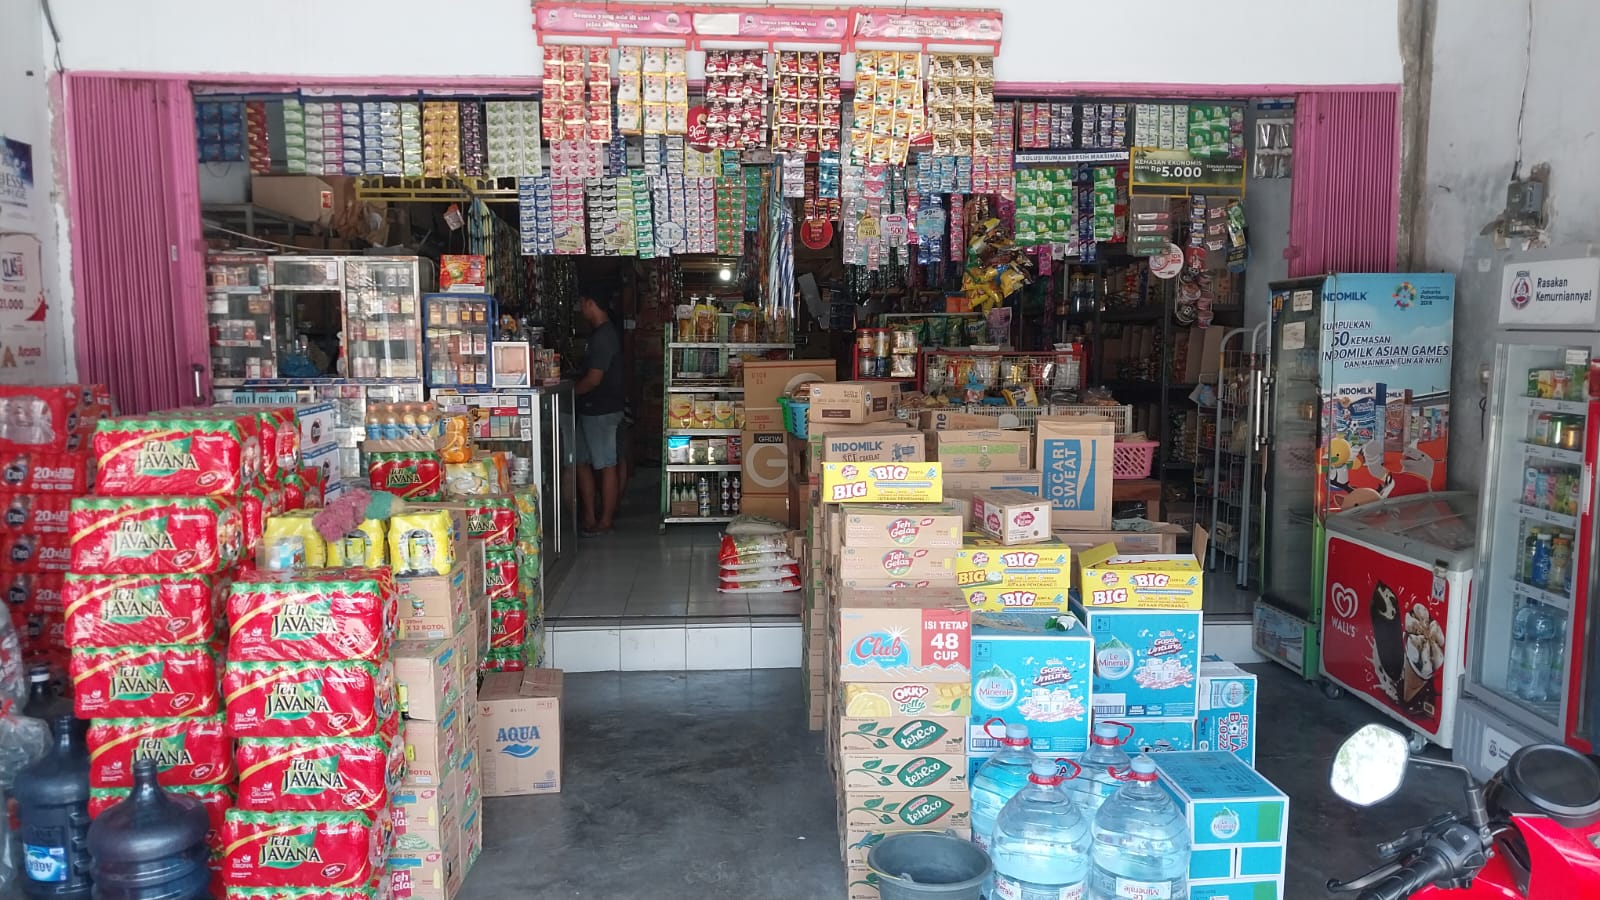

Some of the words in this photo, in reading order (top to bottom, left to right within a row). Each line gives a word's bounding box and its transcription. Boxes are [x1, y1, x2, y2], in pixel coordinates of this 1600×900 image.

[1537, 277, 1568, 288] Rasakan
[1322, 291, 1368, 302] NDOMILK
[1536, 290, 1592, 304] Kemurniannya!
[1331, 331, 1350, 347] 50
[1350, 335, 1391, 345] KEMASAN
[1322, 346, 1373, 361] INDOMILK
[1375, 345, 1408, 357] ASIAN
[1411, 345, 1449, 356] GAMES
[1344, 360, 1359, 369] DAN
[1361, 358, 1395, 367] MAINKAN
[1339, 386, 1374, 395] INDOMILK
[758, 435, 783, 443] GROW
[145, 441, 167, 453] Teh
[832, 441, 883, 452] INDOMILK
[136, 454, 197, 475] JAVANA
[874, 464, 909, 480] BIG
[1052, 441, 1065, 508] POCARI
[1063, 447, 1077, 508] SWEAT
[387, 474, 420, 486] JAVANA
[832, 481, 868, 500] BIG
[120, 520, 143, 532] Teh
[467, 521, 497, 531] AVANA
[895, 519, 911, 529] Teh
[890, 527, 916, 538] Gelas
[113, 534, 174, 557] JAVANA
[889, 551, 905, 561] Teh
[1004, 552, 1039, 567] BIG
[885, 559, 910, 569] Gelas
[957, 570, 986, 585] BIG
[1134, 573, 1170, 587] BIG
[1001, 591, 1037, 606] BIG
[1093, 588, 1128, 605] BIG
[103, 600, 167, 619] JAVANA
[273, 616, 337, 637] JAVANA
[924, 621, 937, 630] ISI
[940, 621, 968, 630] TETAP
[1331, 615, 1356, 638] WALL'S
[855, 636, 902, 659] Club
[930, 633, 960, 649] 48
[933, 651, 959, 661] CUP
[1099, 659, 1129, 667] Minerale
[119, 665, 140, 677] Teh
[111, 677, 172, 697] JAVANA
[276, 684, 297, 695] Teh
[979, 687, 1014, 696] Minerale
[991, 681, 1000, 690] Le
[893, 685, 929, 703] OKKY
[266, 694, 330, 717] JAVANA
[496, 725, 541, 743] AQUA
[1219, 716, 1229, 749] 2022
[1240, 715, 1249, 749] PESTA
[140, 738, 161, 749] Teh
[132, 749, 192, 766] JAVANA
[291, 759, 314, 770] Teh
[283, 770, 344, 792] JAVANA
[269, 836, 290, 846] Teh
[260, 845, 321, 865] JAVANA
[392, 882, 415, 891] elas
[1123, 886, 1160, 896] Minerale
